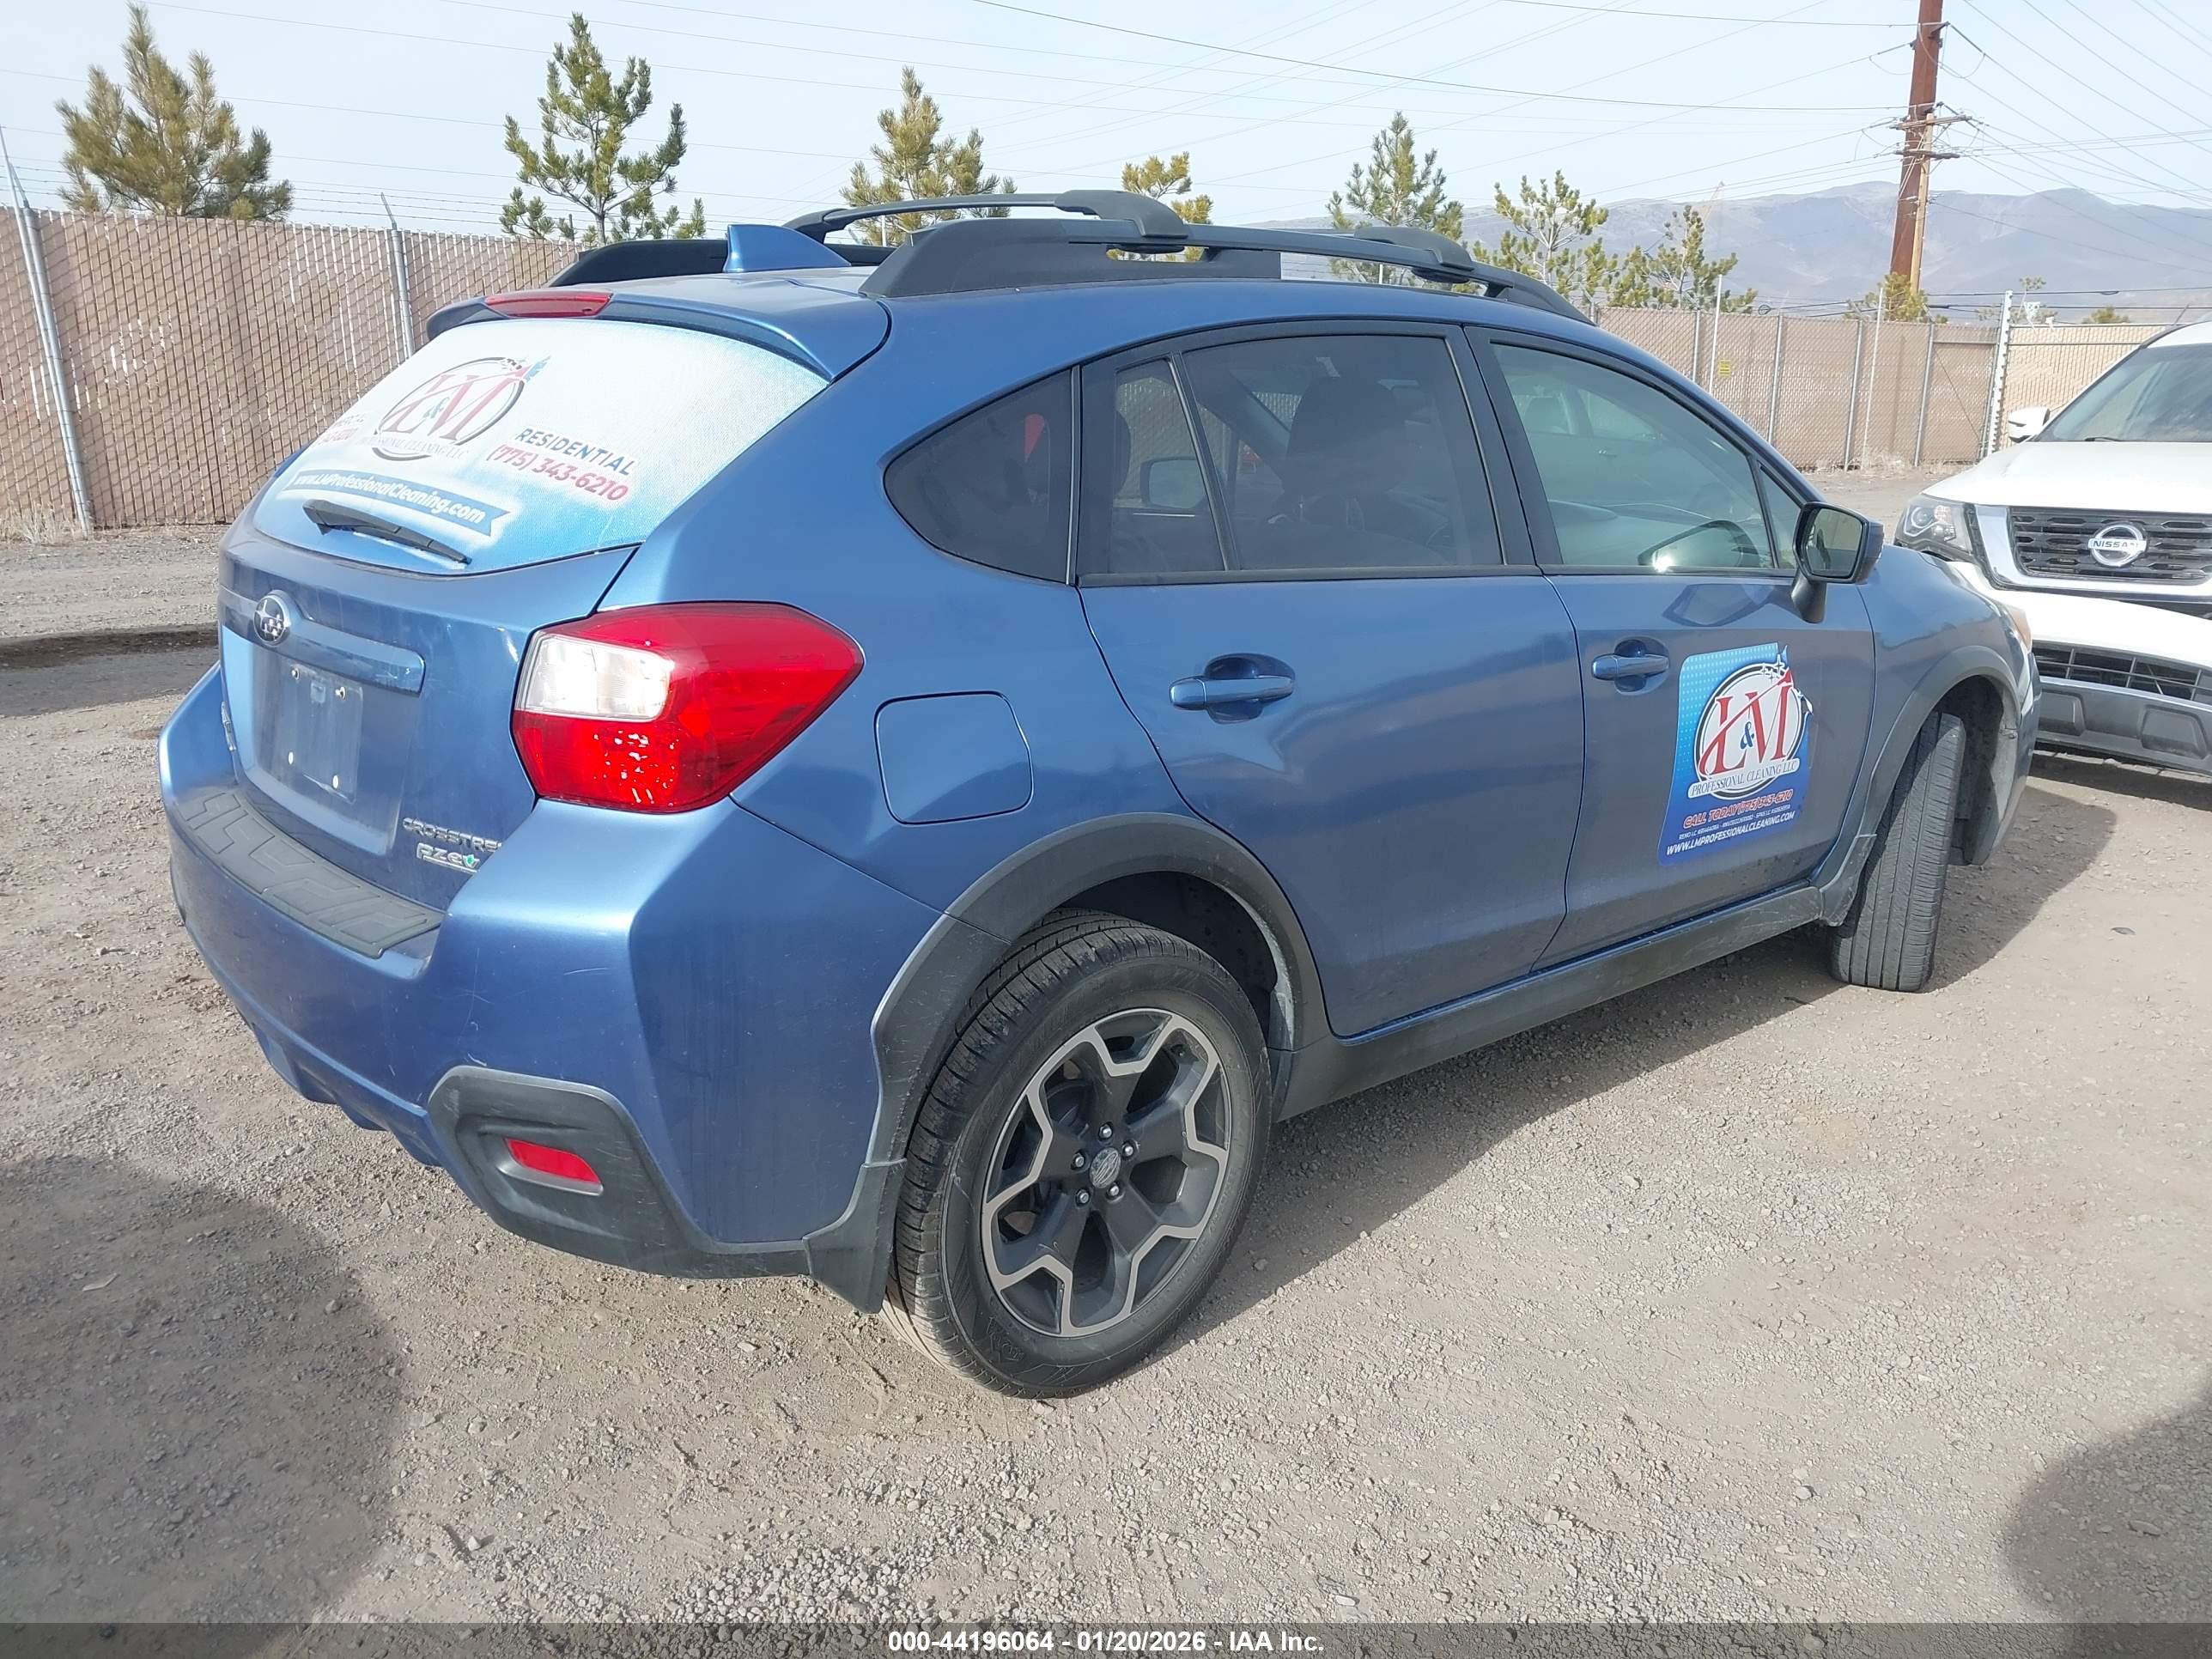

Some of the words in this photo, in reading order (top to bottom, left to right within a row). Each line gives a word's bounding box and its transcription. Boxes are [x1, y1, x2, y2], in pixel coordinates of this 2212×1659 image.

[486, 444, 538, 471] (775)
[532, 458, 629, 501] 343-6210
[515, 428, 635, 476] RESIDENTIAL
[1691, 774, 1745, 796] PROFESSIONAL
[1746, 763, 1782, 782] CLEANING
[1782, 760, 1797, 773] LLC
[1666, 811, 1796, 855] WWW.LMPROFESSIONALCLEANING.COM
[1683, 813, 1707, 830] CALL
